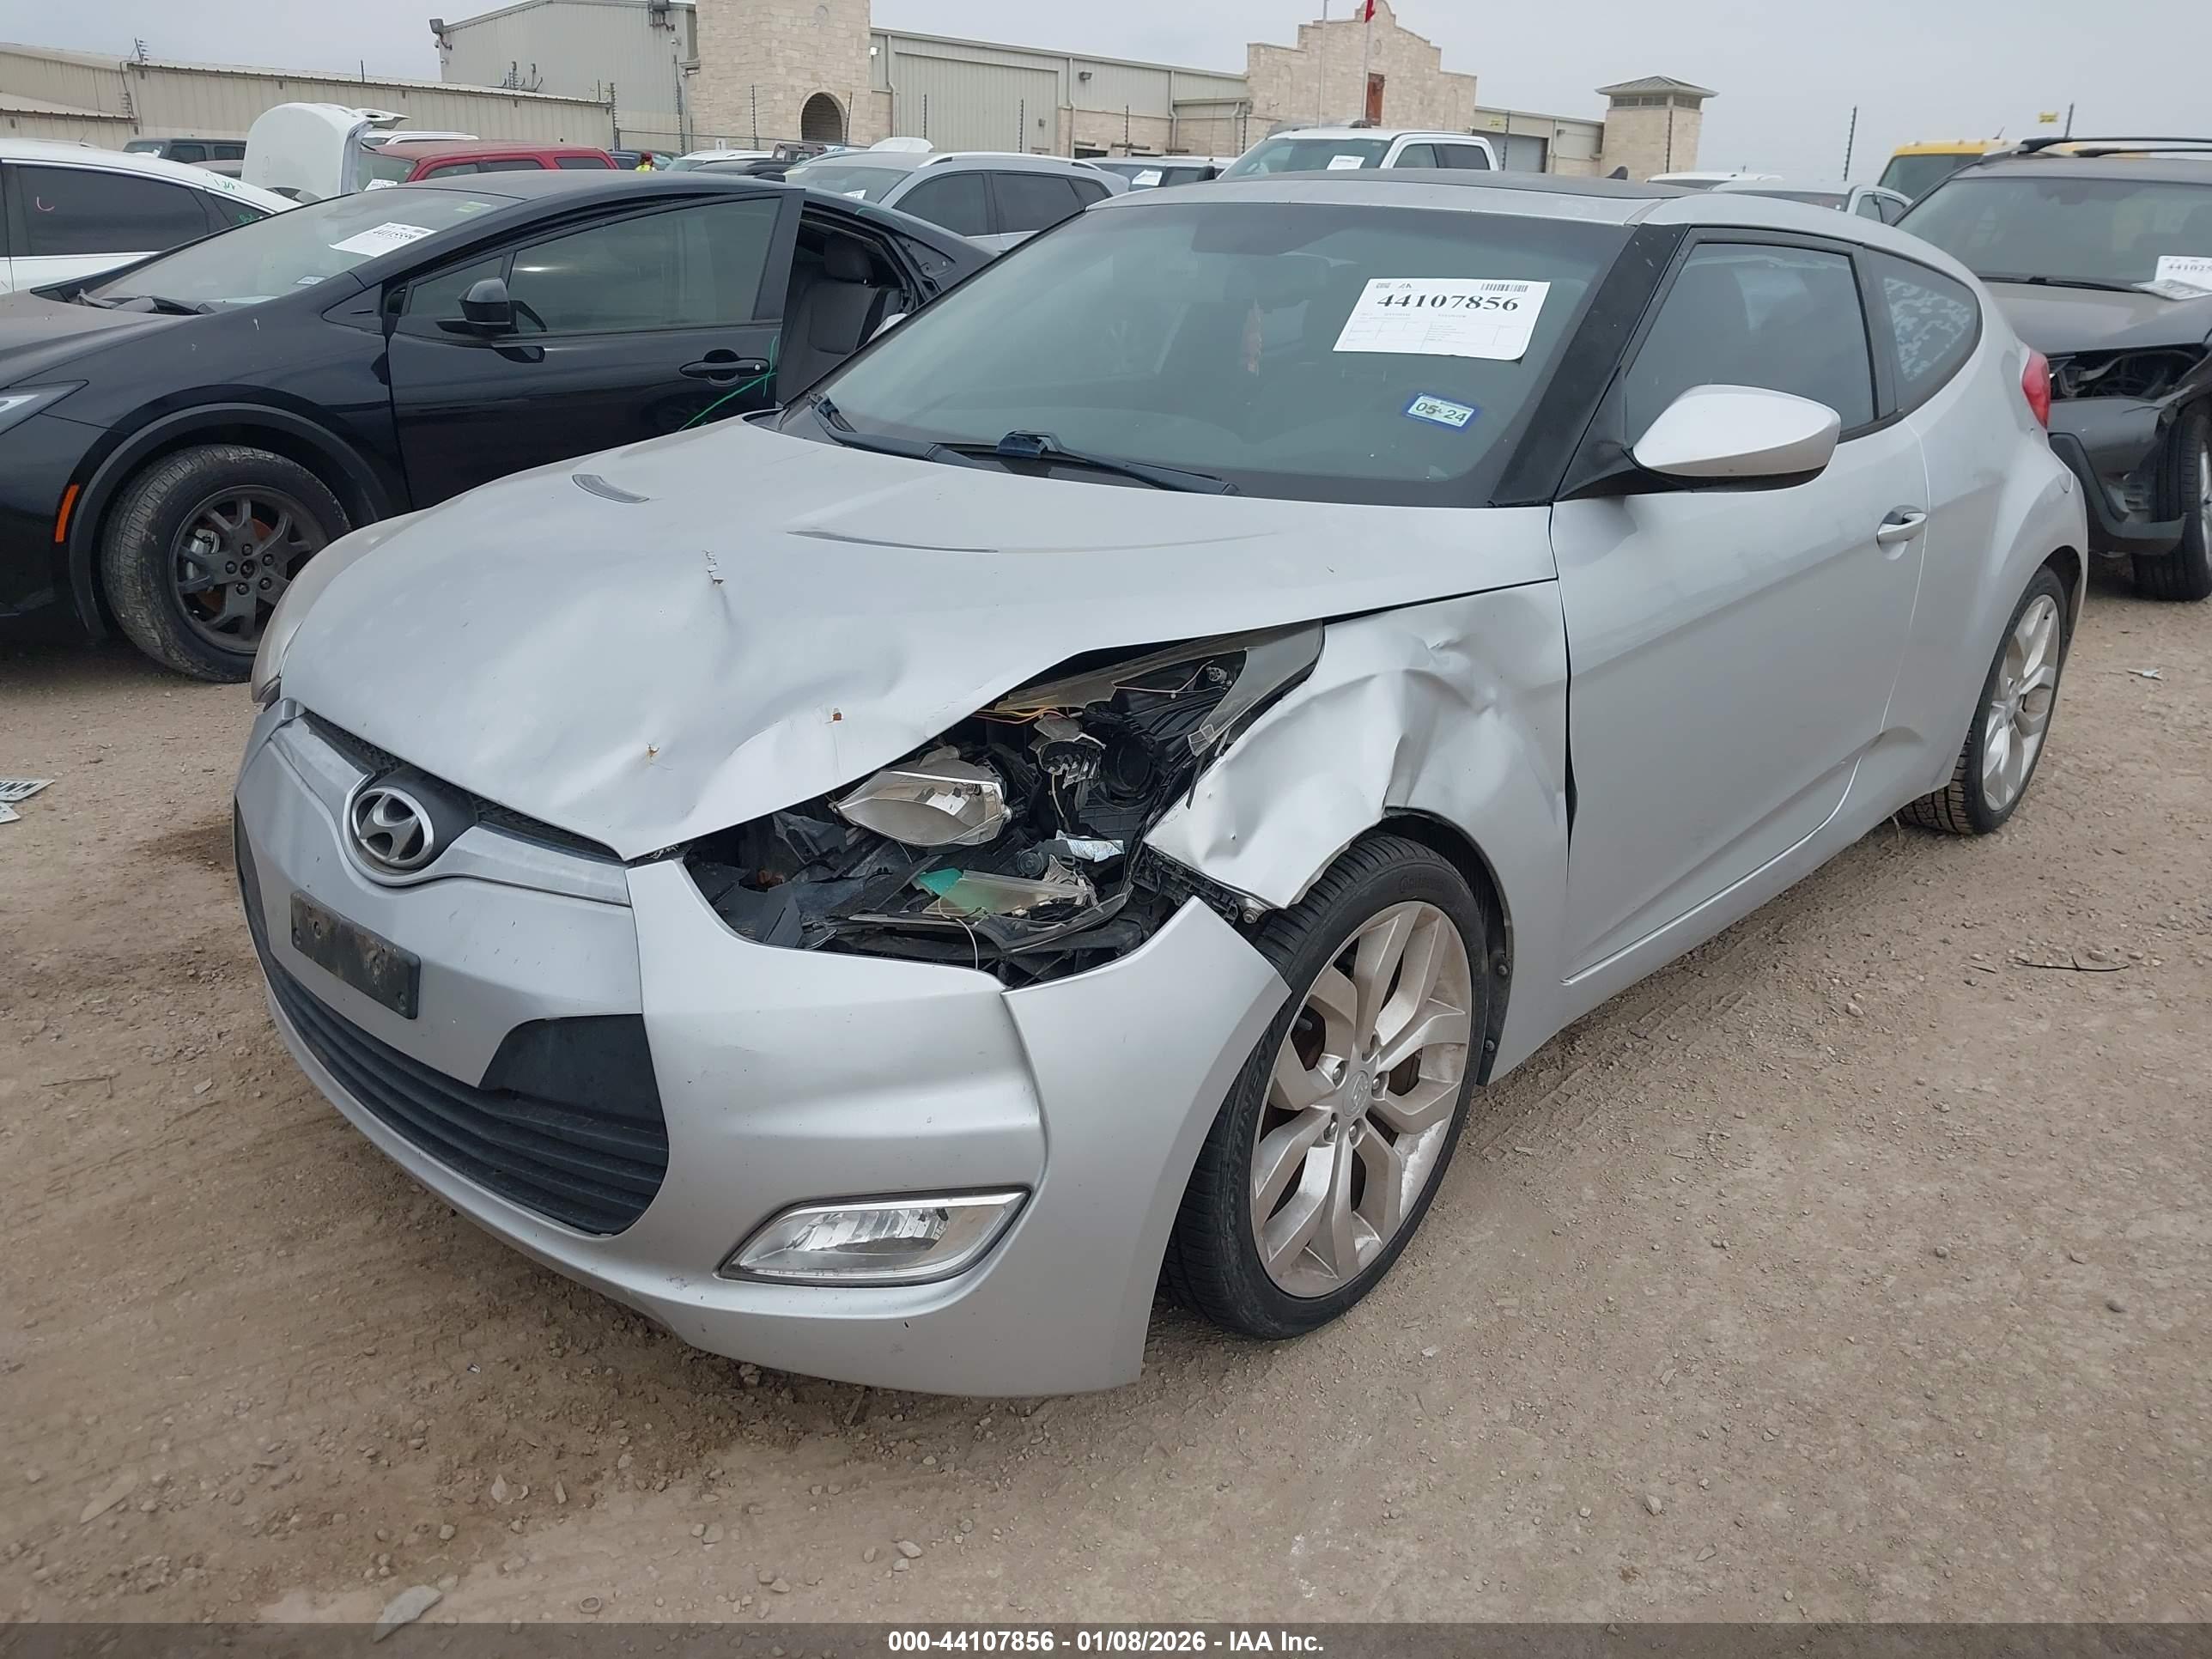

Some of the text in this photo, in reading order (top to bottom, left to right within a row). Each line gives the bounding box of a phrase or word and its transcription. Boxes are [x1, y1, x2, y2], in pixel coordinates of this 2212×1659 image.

[1376, 294, 1519, 311] 44107856
[1415, 402, 1438, 414] 05
[1443, 410, 1467, 422] 24
